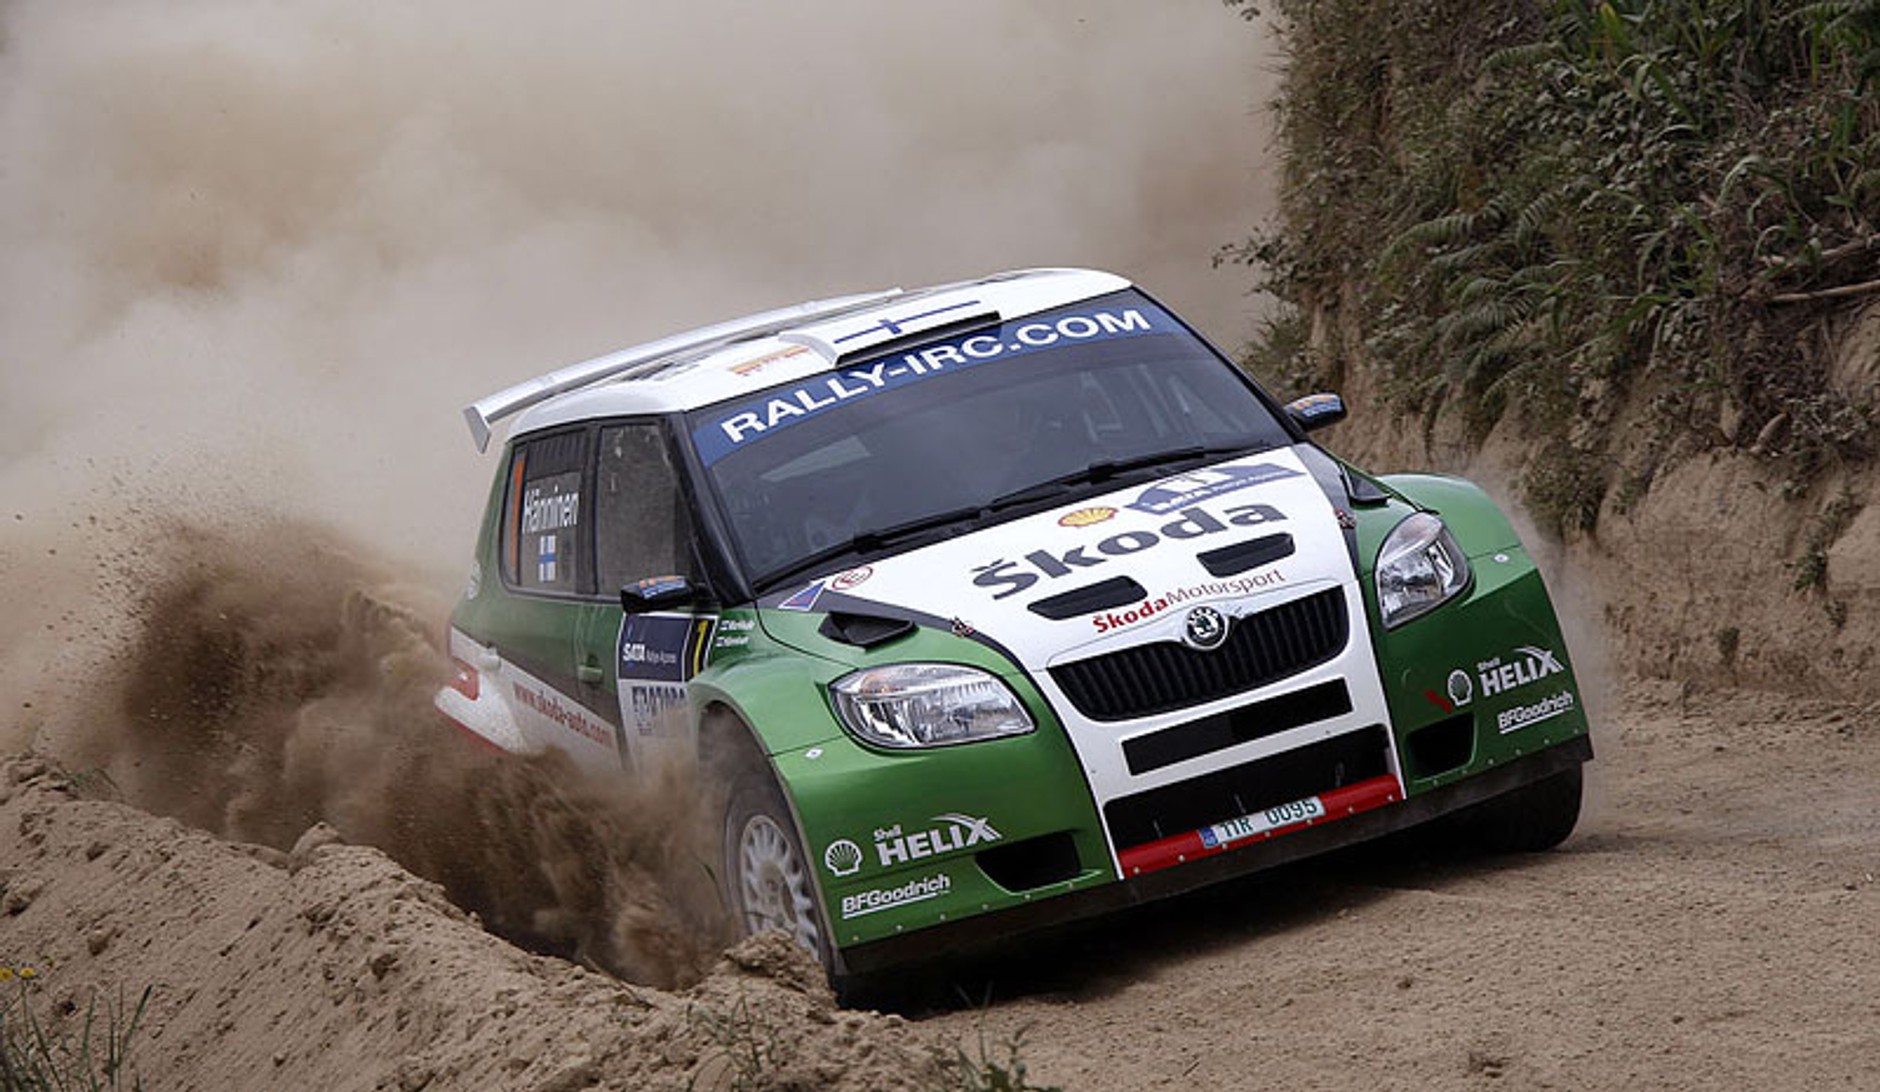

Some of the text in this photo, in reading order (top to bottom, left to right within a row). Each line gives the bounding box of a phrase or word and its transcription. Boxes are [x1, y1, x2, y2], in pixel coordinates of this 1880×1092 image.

[721, 309, 1151, 442] RALLY-IRC.COM
[522, 484, 580, 535] Hänninen
[972, 504, 1288, 600] Škoda
[693, 620, 708, 677] 1
[1479, 650, 1564, 697] HELIX
[1497, 690, 1574, 730] BFGoodrich
[1265, 800, 1318, 825] 0095
[875, 815, 1002, 866] HELIX
[842, 873, 951, 914] BFGoodrich
